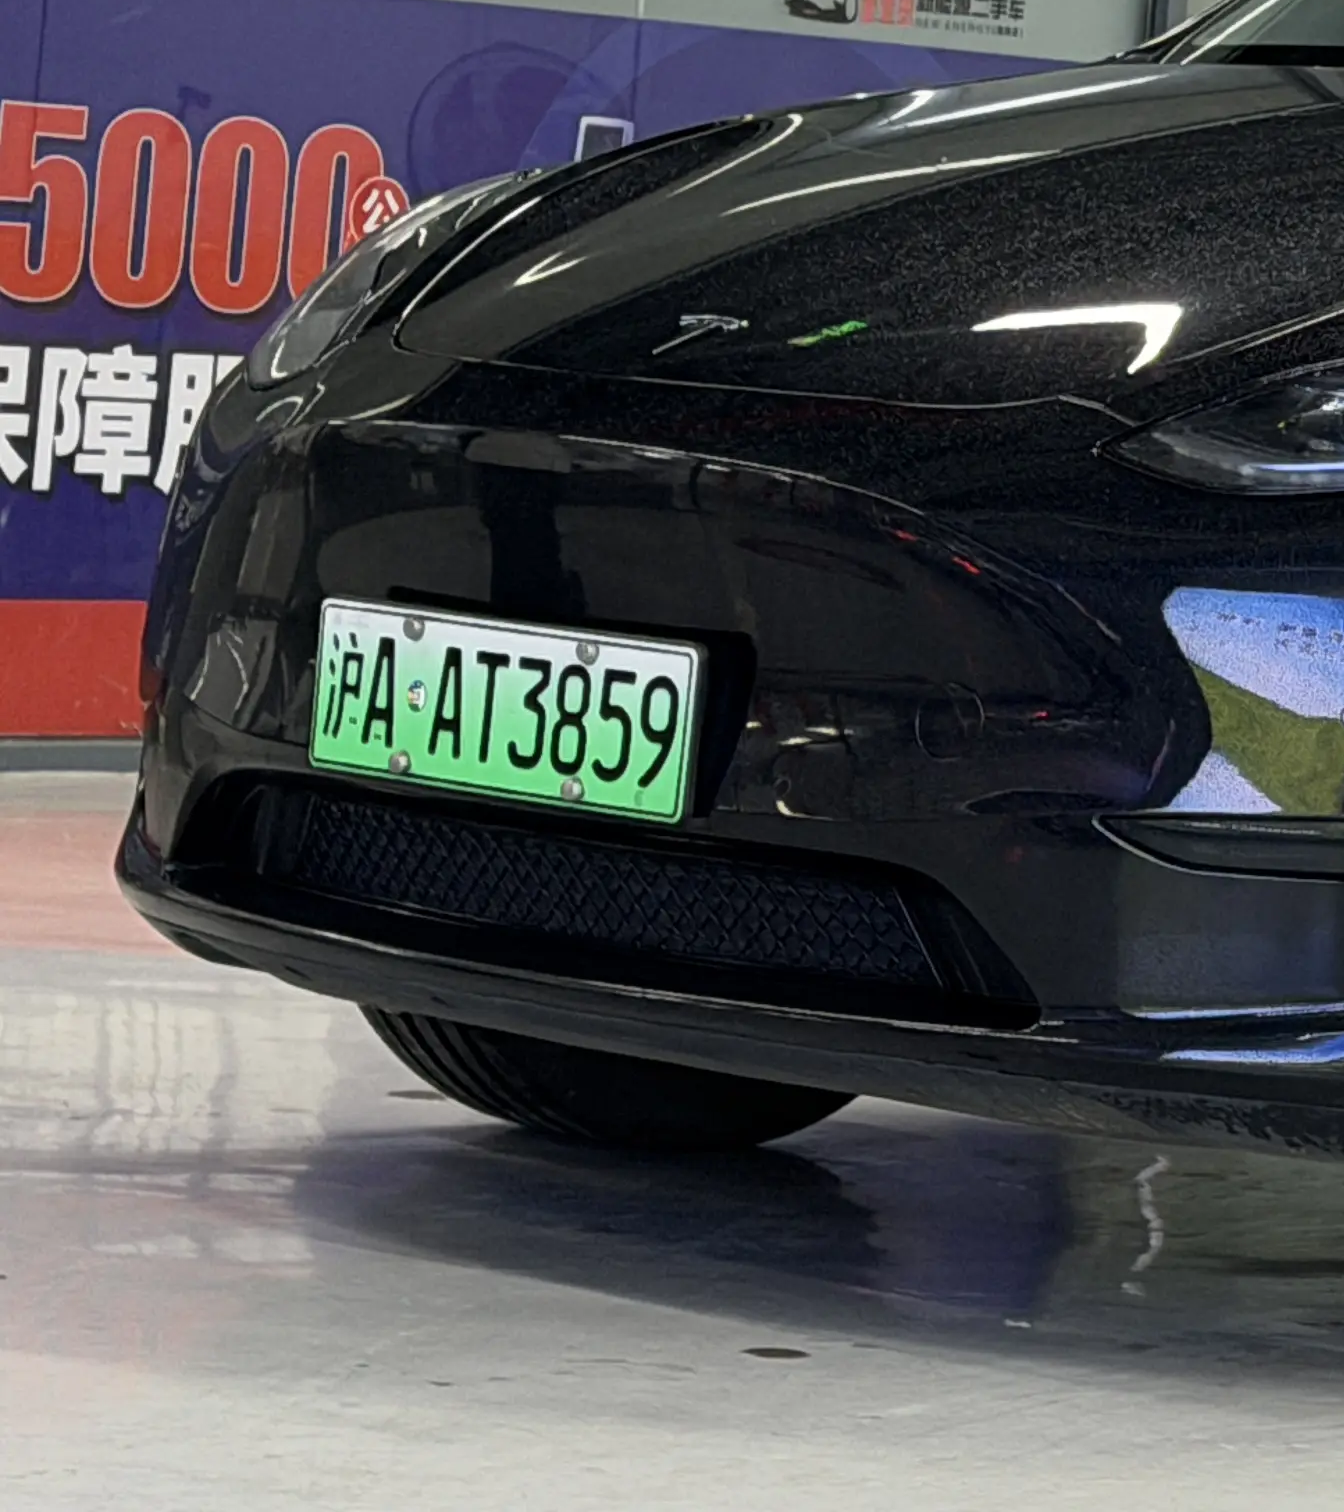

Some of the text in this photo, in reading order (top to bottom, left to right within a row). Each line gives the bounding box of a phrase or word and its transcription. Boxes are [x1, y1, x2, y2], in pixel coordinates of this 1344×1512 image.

[0, 100, 386, 315] 5000
[322, 632, 680, 789] 沪A AT3859
